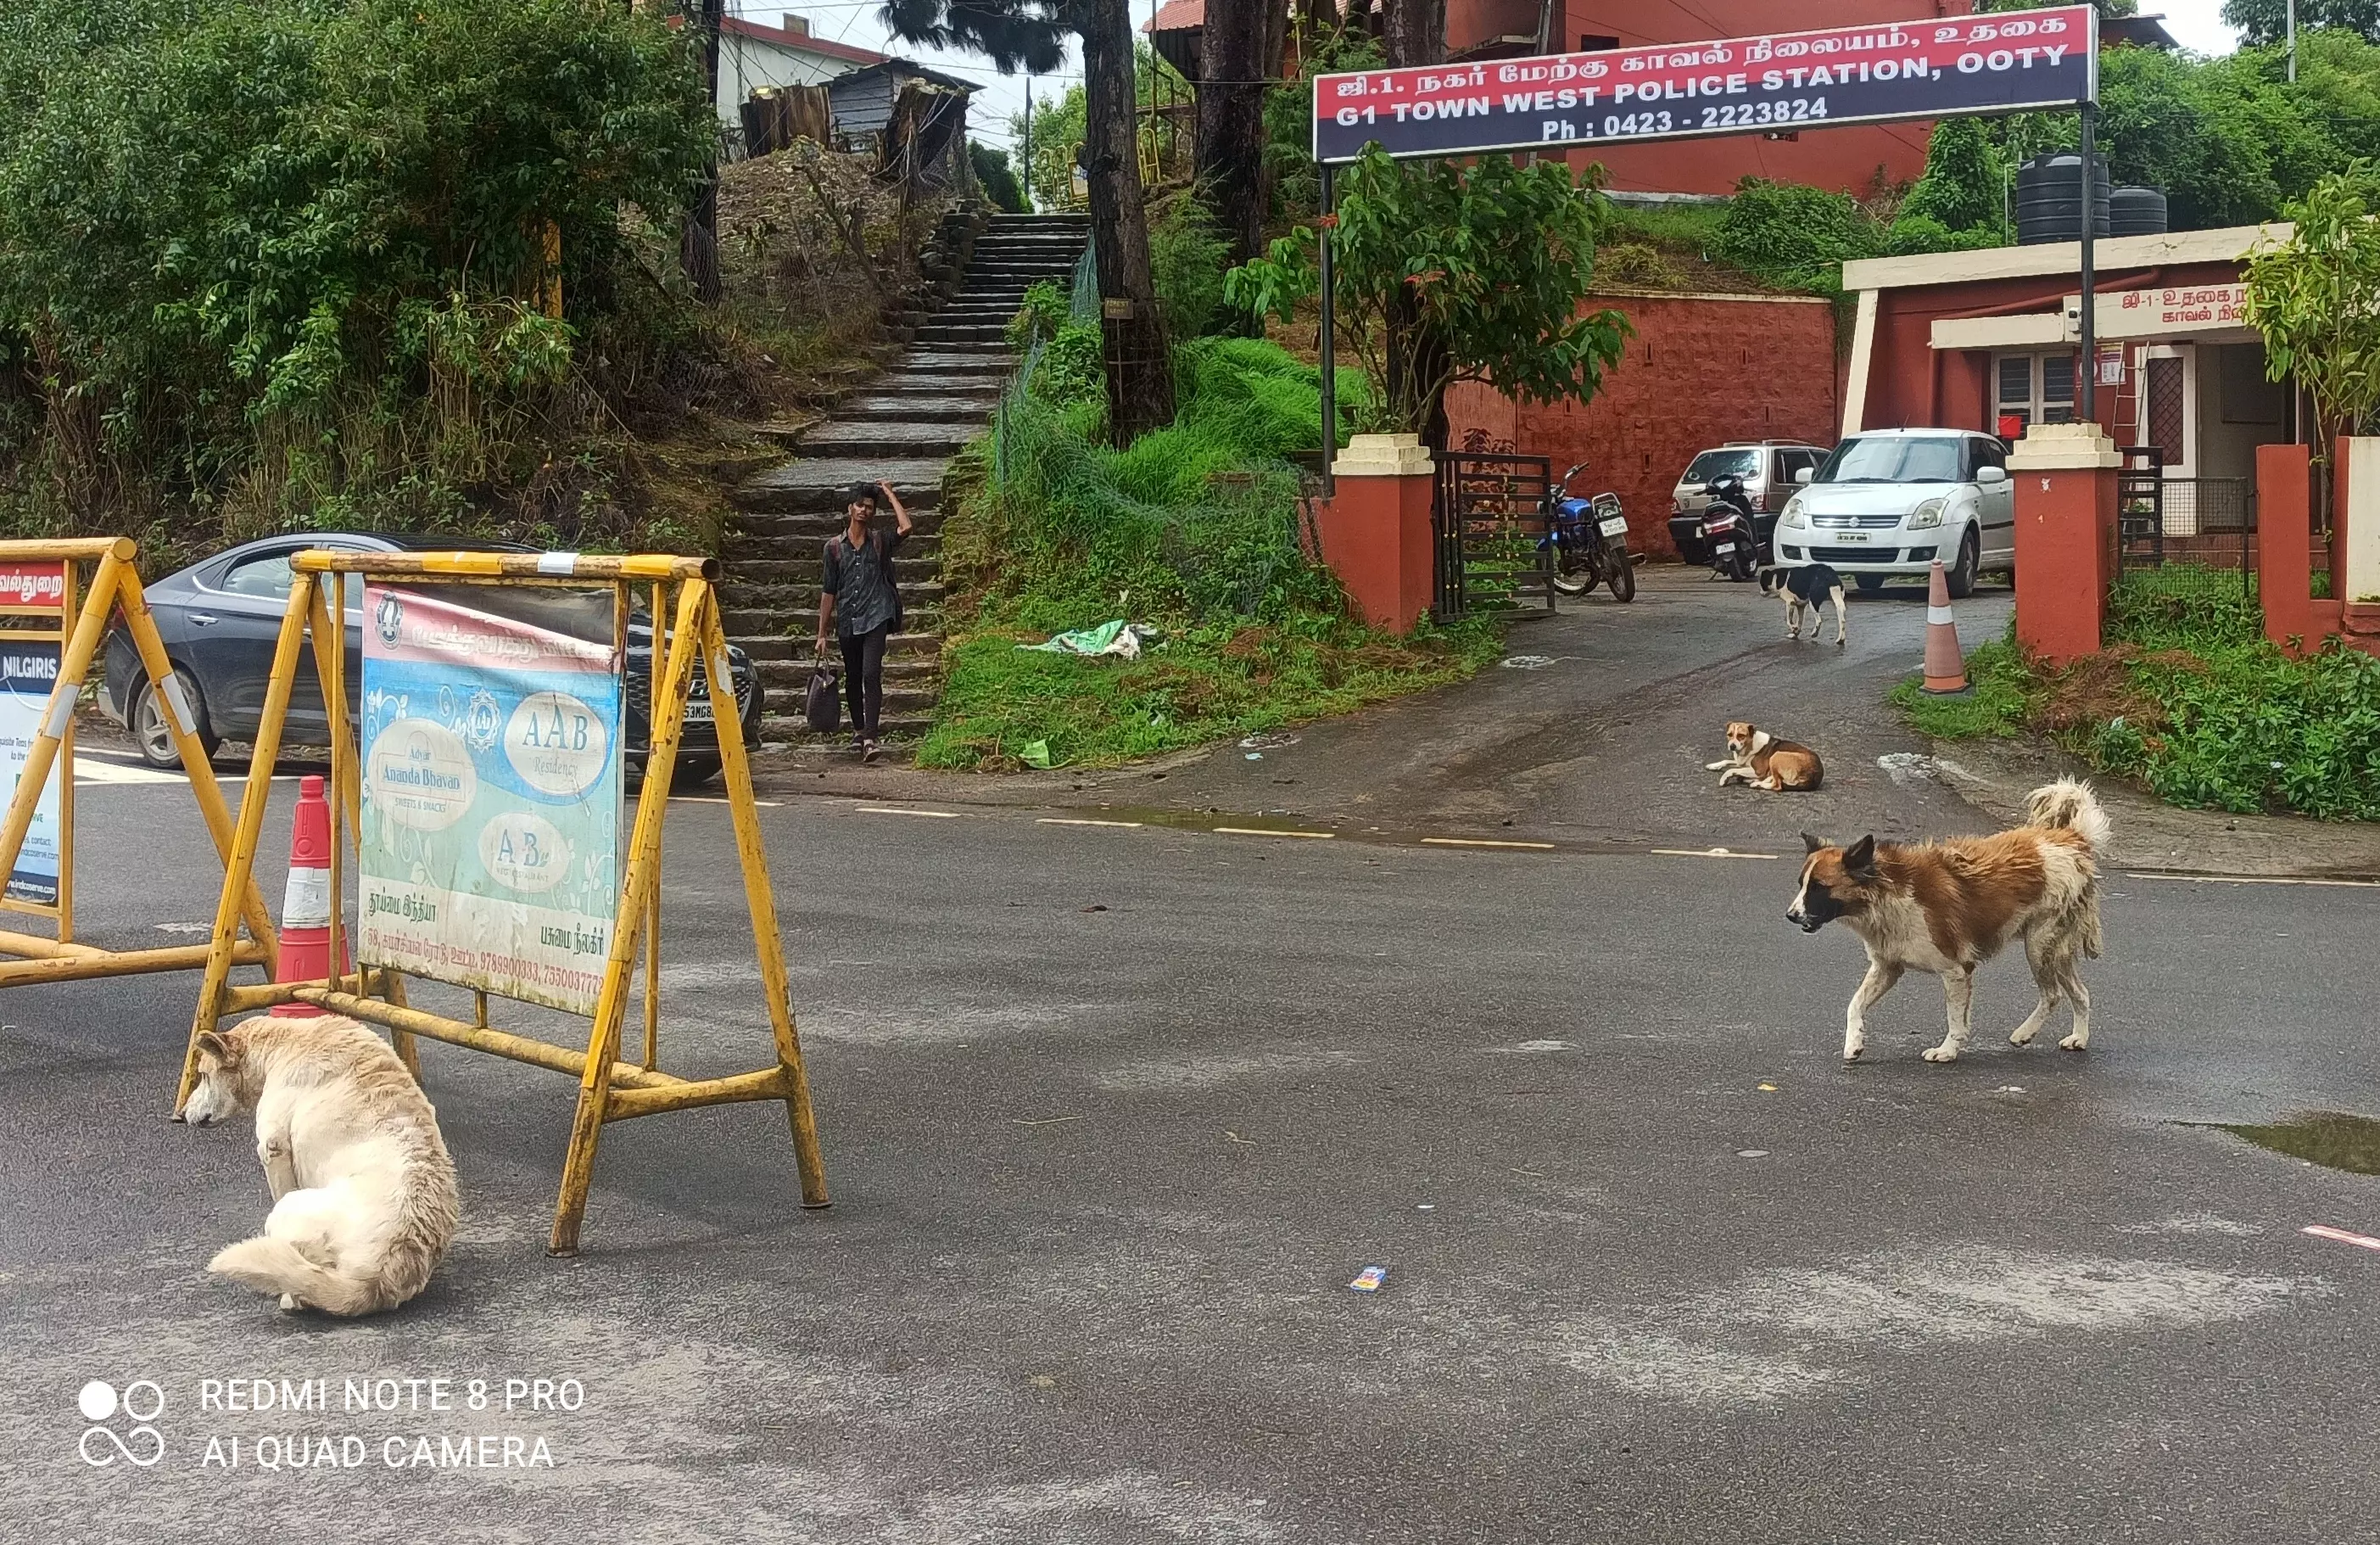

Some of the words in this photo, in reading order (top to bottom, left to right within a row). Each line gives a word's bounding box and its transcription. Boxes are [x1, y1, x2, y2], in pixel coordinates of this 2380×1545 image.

[1415, 64, 1489, 96] நகர்
[1499, 57, 1608, 84] மேற்கு
[1621, 42, 1732, 71] காவல்
[1744, 26, 1920, 66] நிலையம்,
[1935, 17, 2066, 46] உதகை
[1337, 105, 1375, 126] G1
[1392, 96, 1489, 122] TOWN
[1506, 87, 1600, 113] WEST
[1615, 73, 1747, 104] POLICE
[1762, 57, 1940, 91] STATION,
[1957, 44, 2070, 74] OOTY
[1543, 120, 1575, 140] Ph
[1605, 110, 1672, 136] 0423
[1701, 97, 1827, 128] 2223824
[2163, 289, 2230, 308] உதகை
[2163, 306, 2211, 322] காவல்
[3, 656, 57, 679] NILGIRIS
[522, 704, 588, 751] AAB
[383, 764, 420, 785] Ananda
[422, 768, 461, 790] Bhavan
[395, 798, 416, 809] SWEETS
[540, 926, 572, 949] பசுமை
